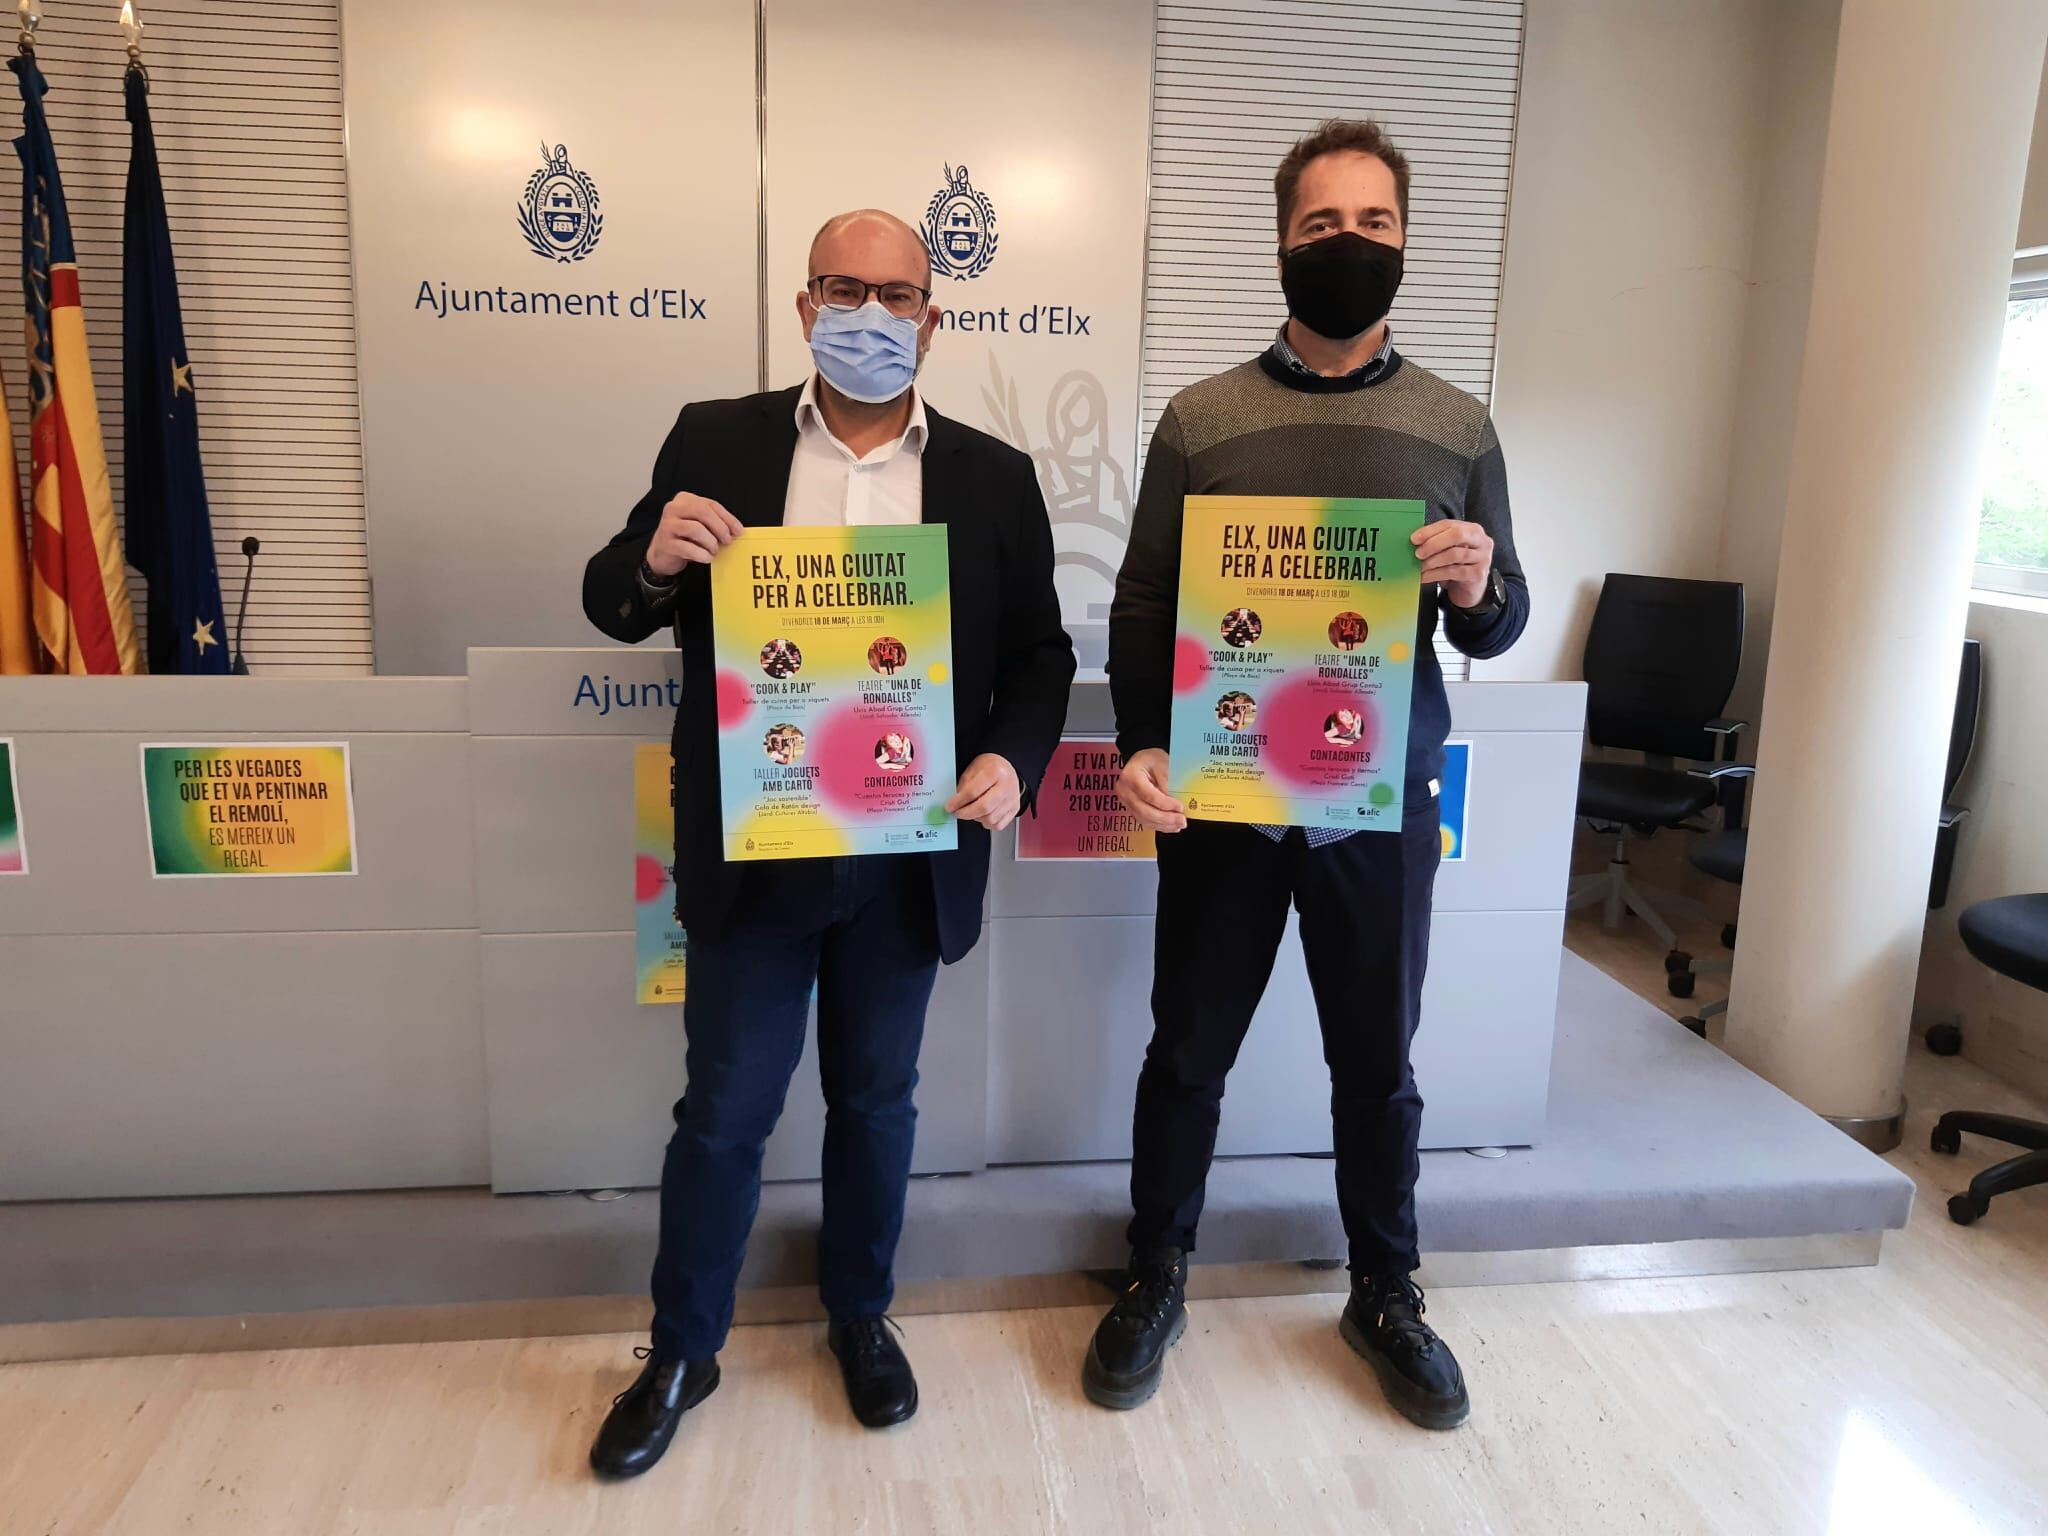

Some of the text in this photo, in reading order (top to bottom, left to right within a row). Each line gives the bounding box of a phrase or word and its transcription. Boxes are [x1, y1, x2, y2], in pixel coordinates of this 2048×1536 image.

[415, 280, 707, 319] Ajuntament d'Elx
[1019, 305, 1090, 335] d'Elx
[1223, 525, 1379, 552] ELX, UNA CIUTAT
[752, 553, 905, 582] ELX, UNA CIUTAT
[1221, 554, 1381, 581] PER A CELEBRAR.
[753, 582, 913, 608] PER A CELEBRAR.
[823, 617, 830, 625] DE
[832, 616, 850, 627] MARÇ
[857, 616, 865, 624] LES
[1209, 651, 1272, 663] "COOK & PLAY"
[1315, 654, 1380, 667] TEATRE "UNA DE
[1319, 667, 1373, 679] RONDALLES"
[751, 682, 816, 694] "COOK & PLAY"
[858, 679, 921, 692] TEATRE "UNA DE
[573, 675, 680, 715] Ajunt
[864, 692, 917, 704] RONDALLES"
[1203, 733, 1267, 745] TALLER JOGUETS
[1210, 746, 1229, 756] AMB
[1310, 750, 1370, 763] CONTACONTES
[174, 760, 302, 778] PER LES VEGADES
[1074, 753, 1087, 769] ET
[1090, 753, 1106, 769] VA
[753, 766, 820, 779] TALLER JOGUETS
[763, 781, 782, 792] AMB
[864, 775, 923, 788] CONTACONTES
[1064, 774, 1071, 790] A
[180, 782, 328, 803] QUE ET VA PENTINAR
[1069, 795, 1090, 811] 218
[210, 801, 288, 824] EL REMOLÍ,
[1088, 816, 1099, 831] ES
[209, 827, 295, 846] ES MEREIX UN
[1078, 836, 1134, 852] UN REGAL.
[224, 850, 268, 867] REGAL.
